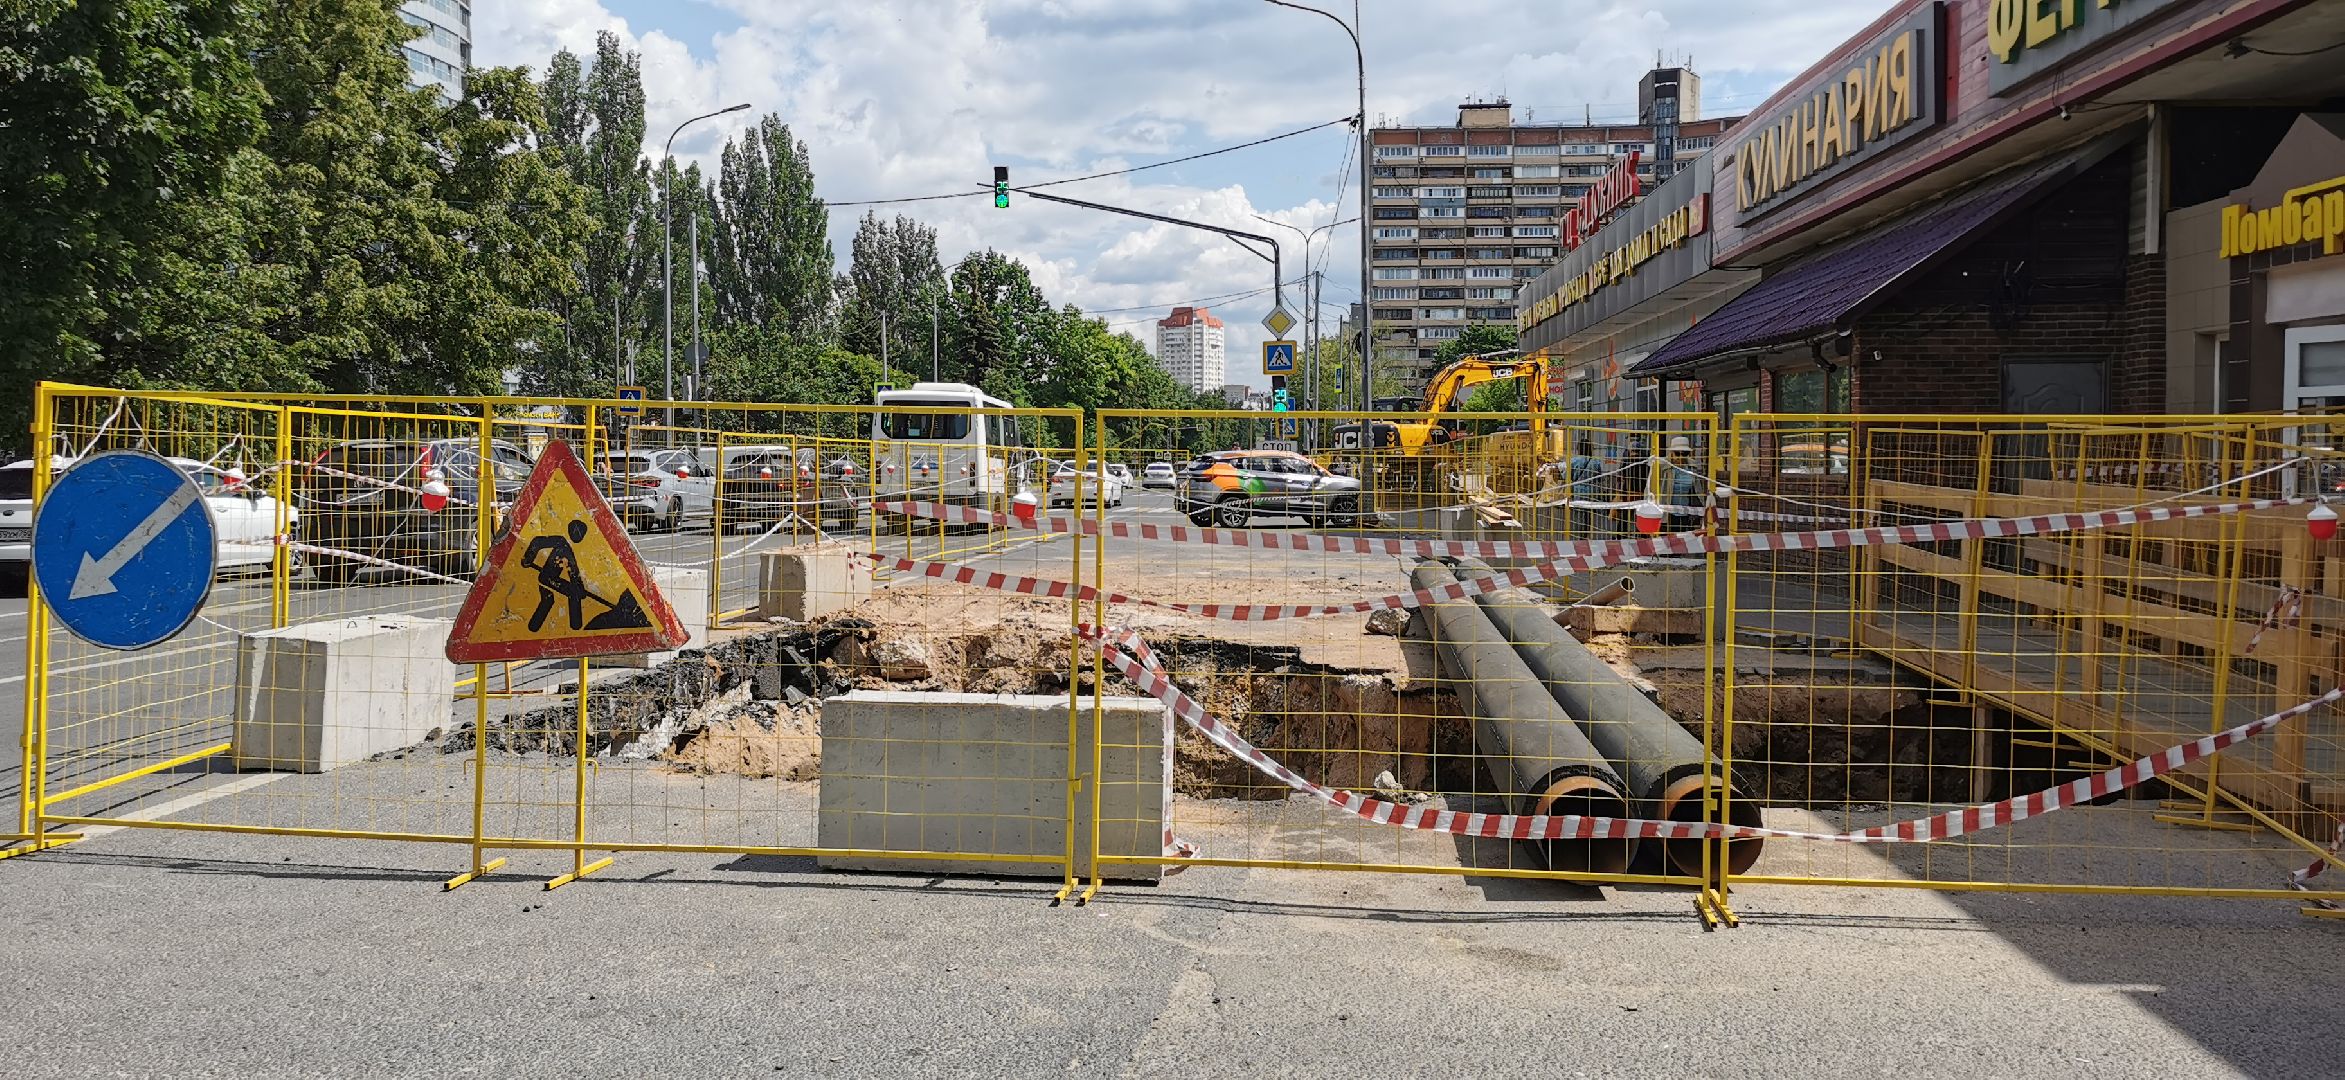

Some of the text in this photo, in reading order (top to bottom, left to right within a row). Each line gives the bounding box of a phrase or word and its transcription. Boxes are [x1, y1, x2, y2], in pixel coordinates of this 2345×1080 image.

[1735, 31, 1910, 213] КУЛИНАРИЯ
[1625, 230, 1651, 277] ДОМА
[1660, 205, 1688, 250] САДА
[1492, 368, 1513, 378] JCB
[1274, 389, 1287, 402] 29
